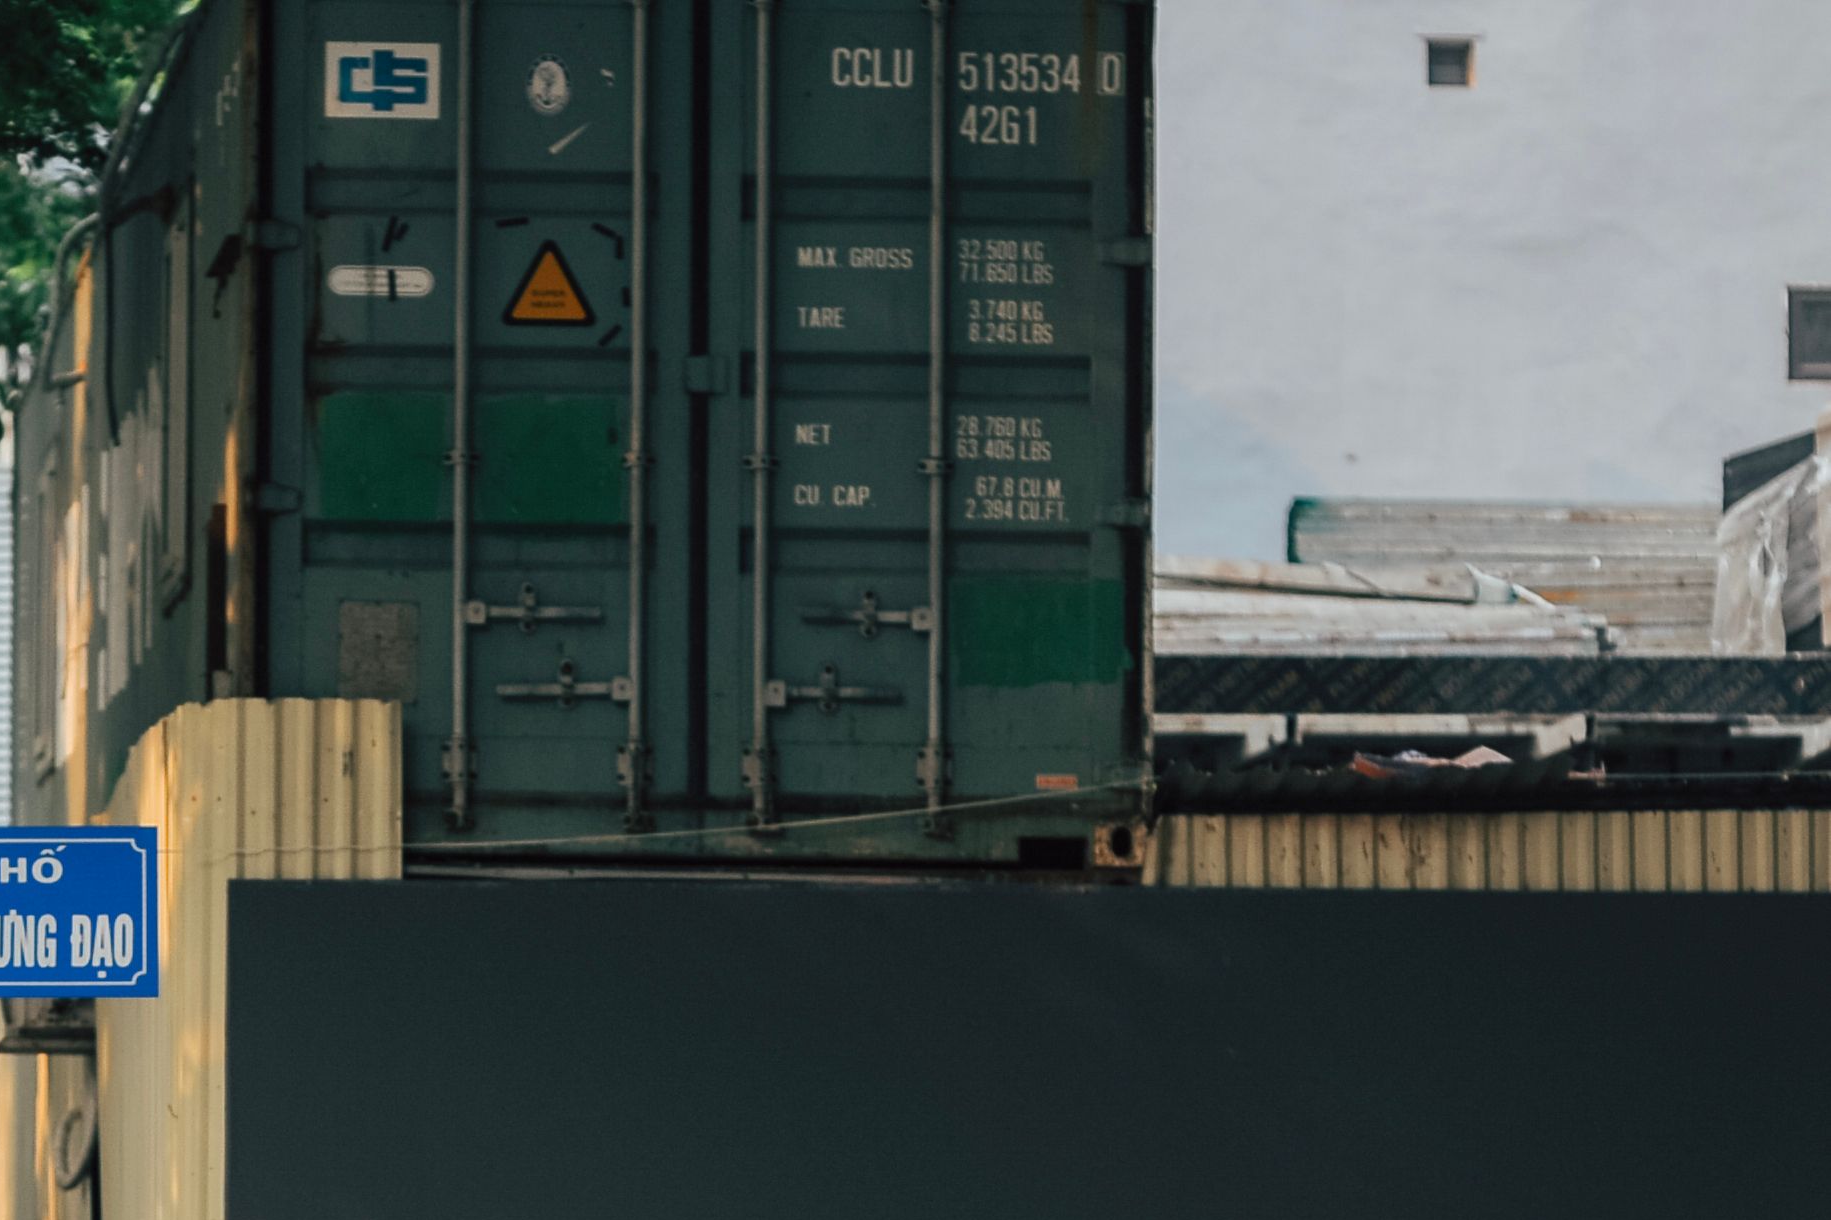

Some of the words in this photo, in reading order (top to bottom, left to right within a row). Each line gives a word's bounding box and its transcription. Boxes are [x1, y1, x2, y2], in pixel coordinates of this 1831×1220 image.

[831, 47, 914, 87] CCLU
[958, 52, 1081, 92] 513534
[958, 105, 1038, 145] 42G1
[850, 248, 914, 269] GROSS
[958, 240, 1017, 260] 32.500
[1022, 240, 1044, 261] KG
[959, 262, 1017, 283] 71.650
[1022, 264, 1054, 285] LBS
[797, 306, 846, 328] TARE
[969, 299, 1017, 321] 3.740
[1022, 301, 1044, 322] KG
[969, 322, 1017, 343] 8.245
[1022, 324, 1053, 345] LBS
[795, 424, 832, 445] NET
[957, 415, 1016, 437] 28.760
[1020, 417, 1042, 439] KG
[956, 438, 1015, 460] 63.405
[1020, 440, 1051, 461] LBS
[965, 499, 1013, 520] 2.394
[70, 913, 134, 978] ĐẠO
